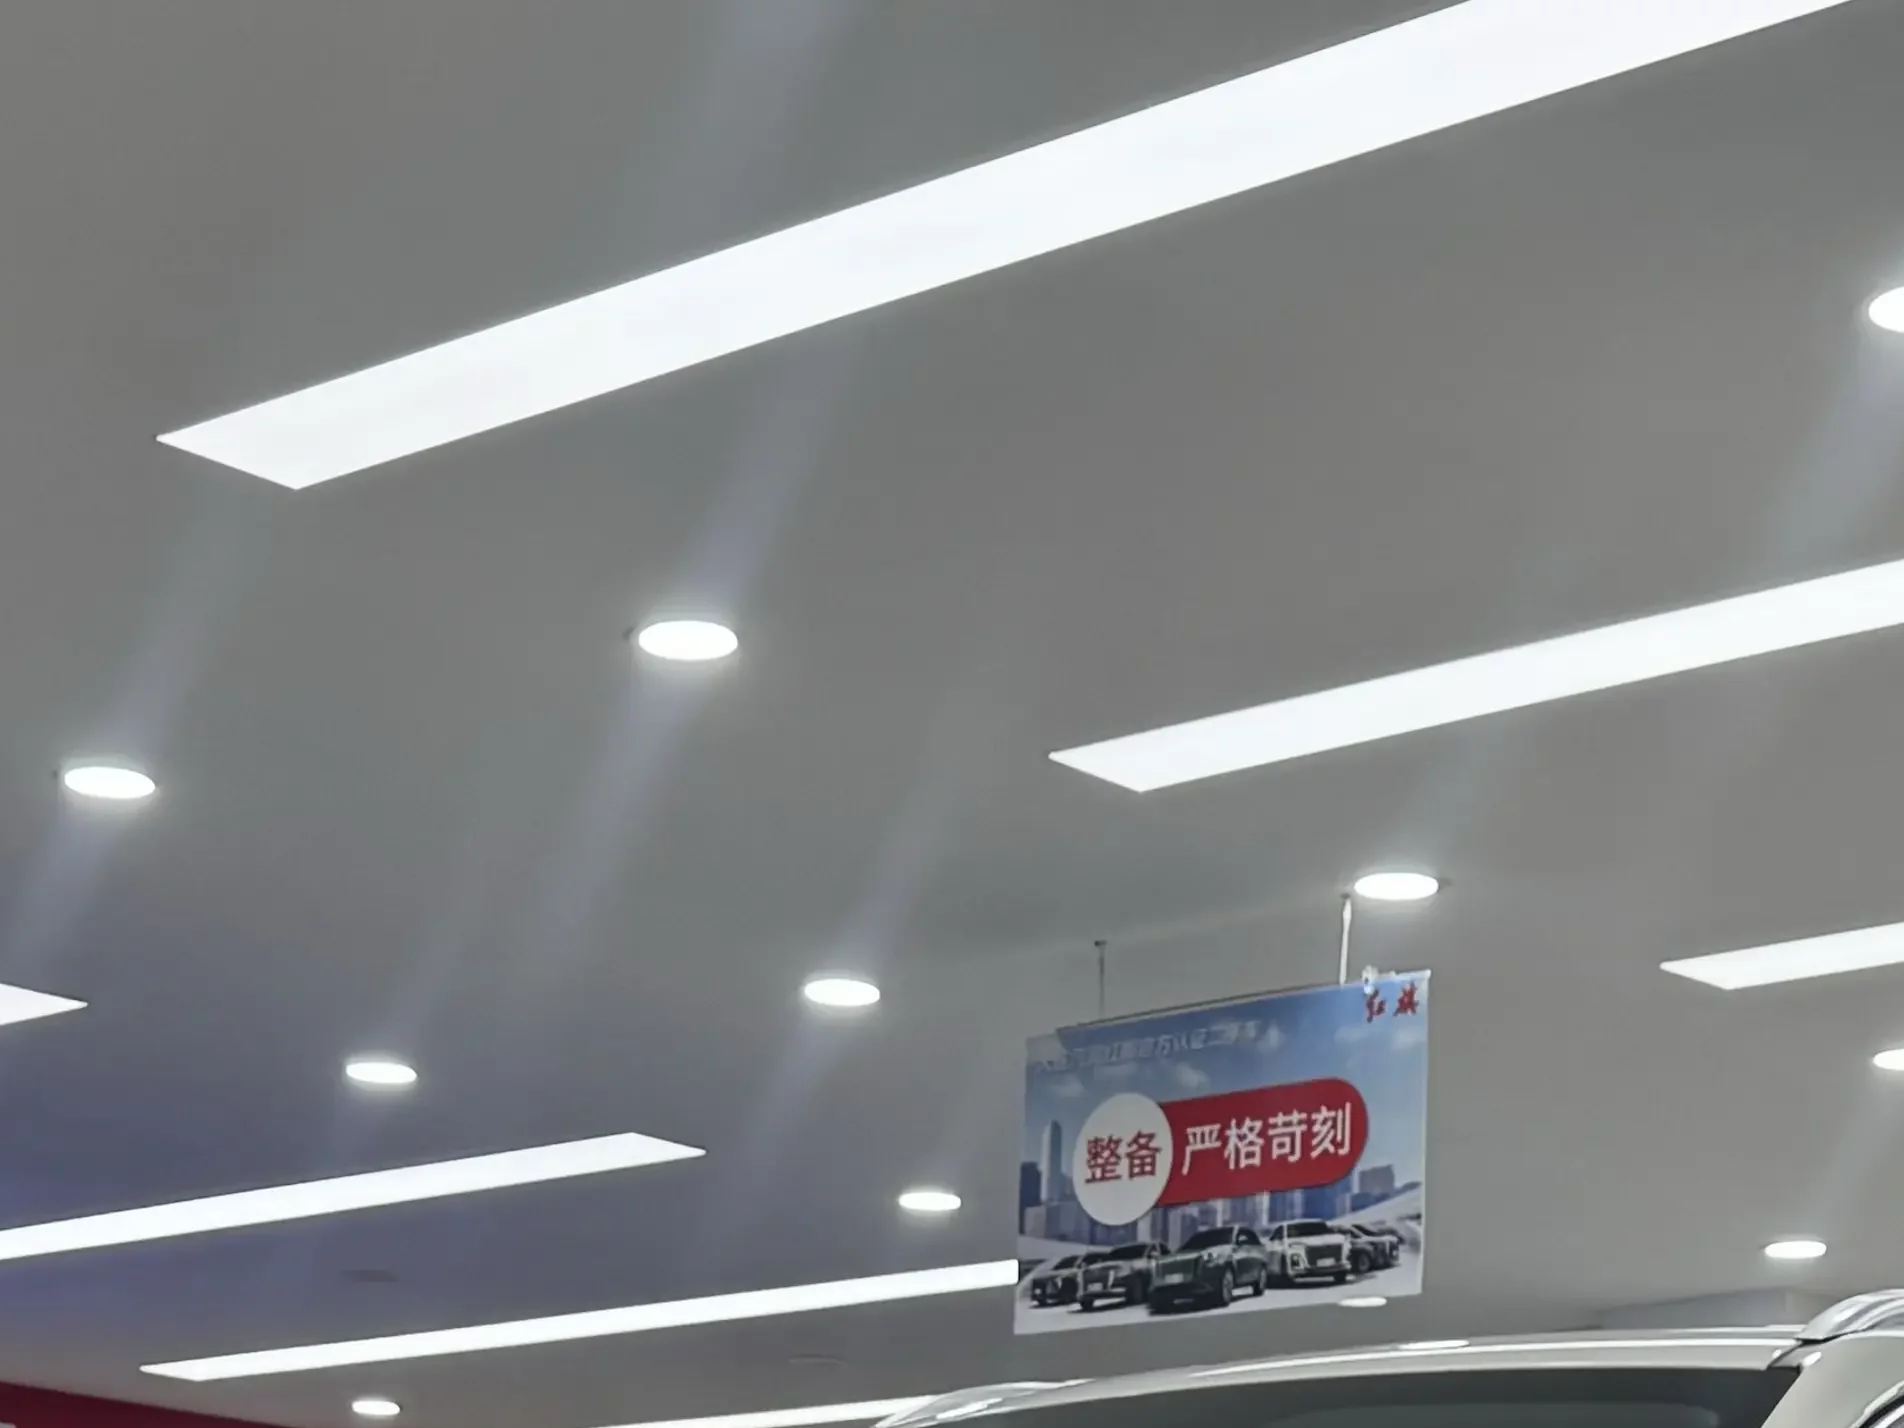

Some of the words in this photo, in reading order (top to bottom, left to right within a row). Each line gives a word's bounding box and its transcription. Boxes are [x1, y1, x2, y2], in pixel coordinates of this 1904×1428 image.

[1085, 1130, 1162, 1183] 整备
[1182, 1101, 1352, 1175] 严格苛刻
